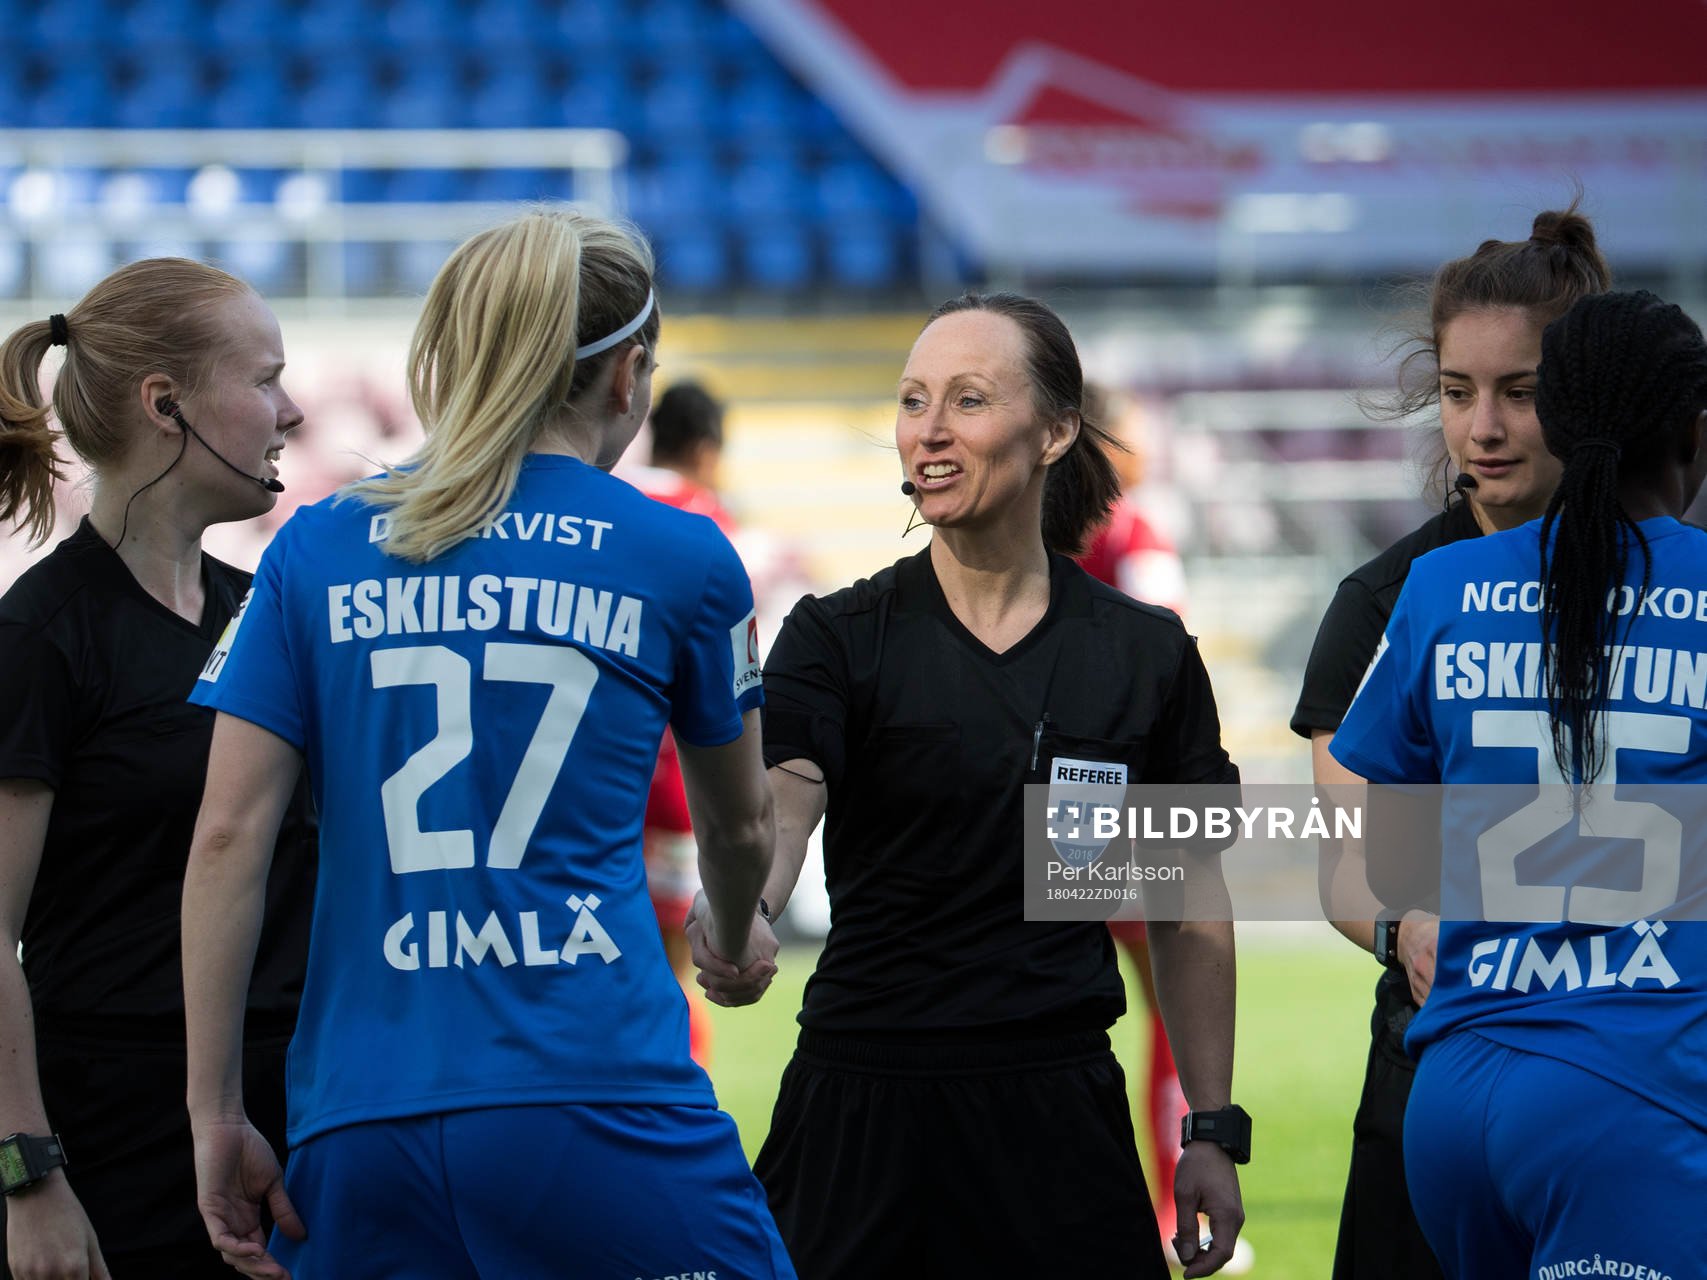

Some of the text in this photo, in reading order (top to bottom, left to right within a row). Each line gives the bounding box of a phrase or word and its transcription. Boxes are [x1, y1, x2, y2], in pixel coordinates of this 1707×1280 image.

[328, 575, 644, 659] ESKILSTUNA
[370, 643, 600, 875] 27
[1057, 766, 1122, 785] REFEREE
[1067, 848, 1094, 861] 2018
[1472, 710, 1692, 927] 25
[383, 893, 623, 971] GIMLÄ
[1467, 919, 1681, 994] GIMLÄ
